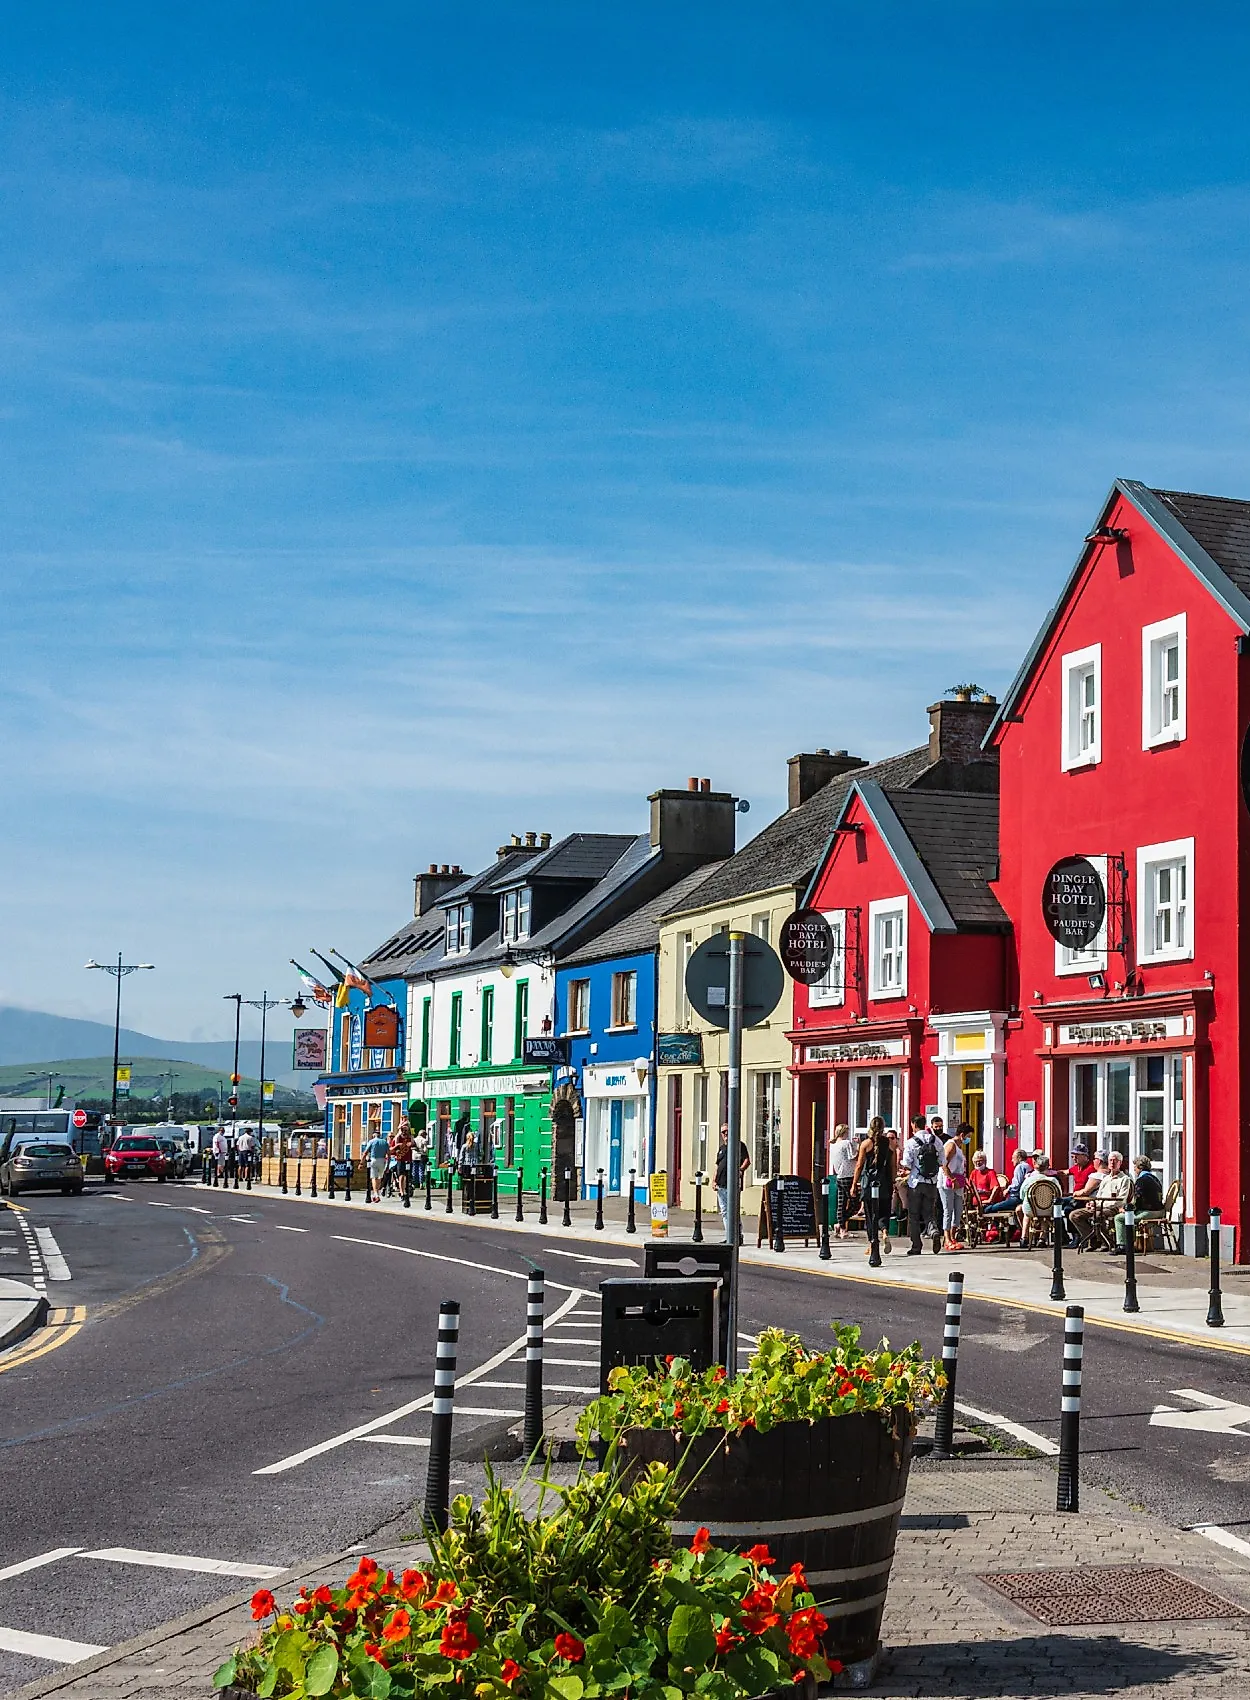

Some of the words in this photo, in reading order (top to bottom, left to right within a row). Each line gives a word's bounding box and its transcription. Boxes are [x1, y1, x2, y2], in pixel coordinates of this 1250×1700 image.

[1052, 873, 1096, 884] DINGLE
[1063, 884, 1084, 894] BAY
[1051, 893, 1097, 906] HOTEL
[789, 923, 827, 932] DINGLE
[1053, 919, 1096, 929] PAUDIE'S
[799, 931, 817, 940] BAY
[1065, 927, 1084, 936] BAR
[788, 939, 827, 949] HOTEL
[790, 960, 826, 968] PAUDIE'S
[439, 1080, 458, 1096] DINGLE
